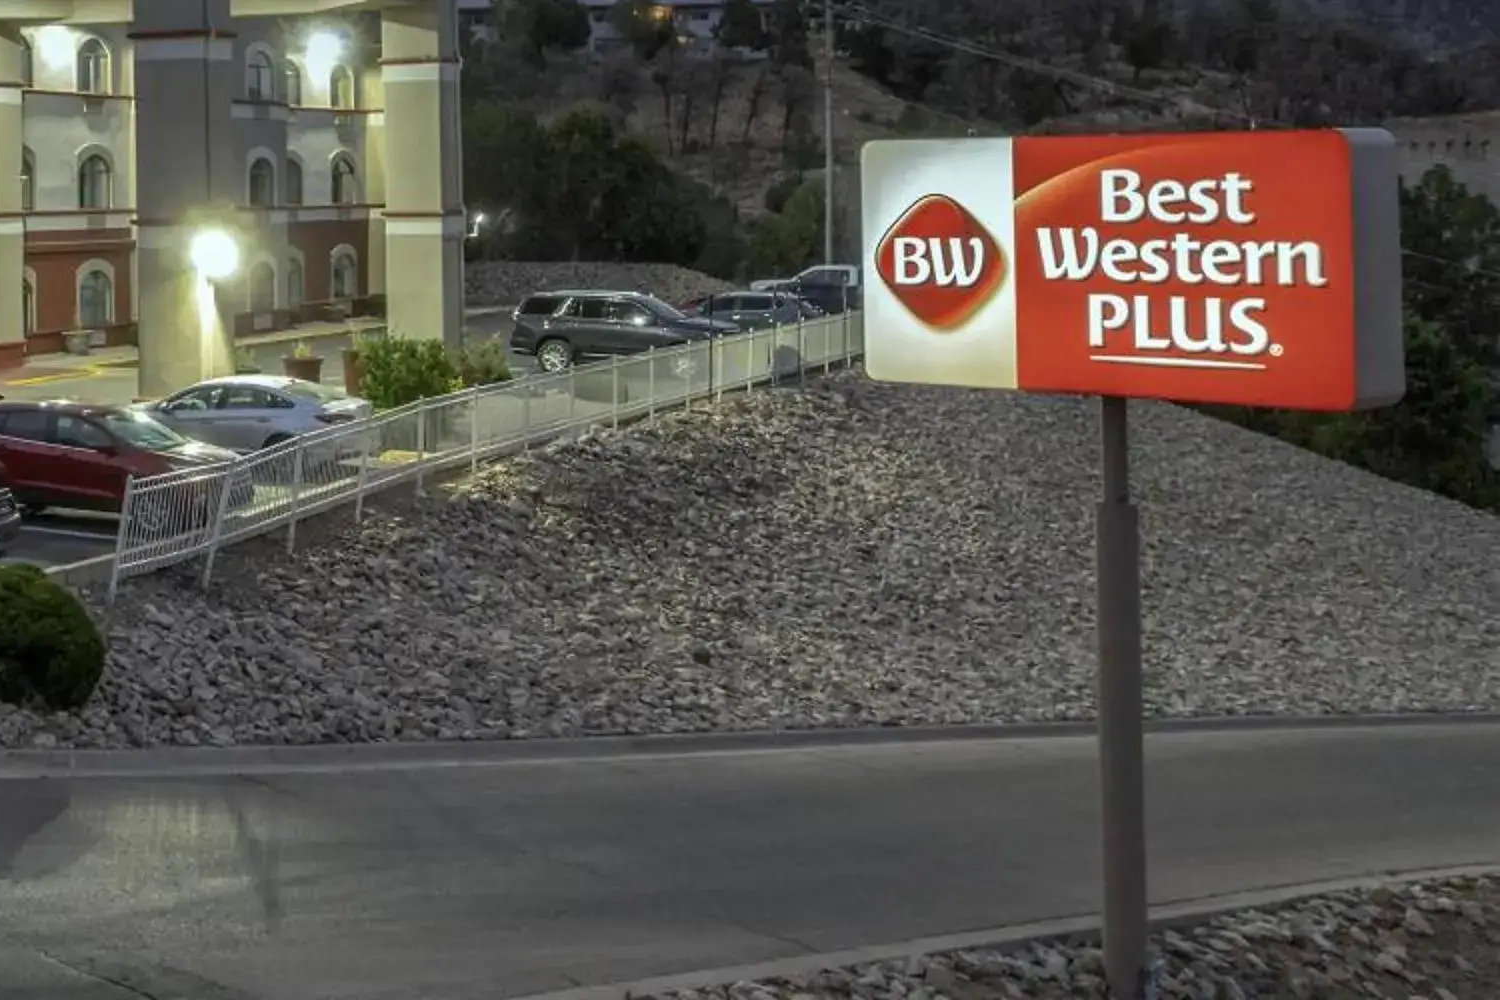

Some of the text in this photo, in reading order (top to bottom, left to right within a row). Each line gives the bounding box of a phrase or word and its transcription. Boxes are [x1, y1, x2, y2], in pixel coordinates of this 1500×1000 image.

[1101, 169, 1254, 224] Best
[893, 236, 984, 287] BW
[1037, 227, 1327, 286] Western
[1088, 294, 1268, 354] PLUS
